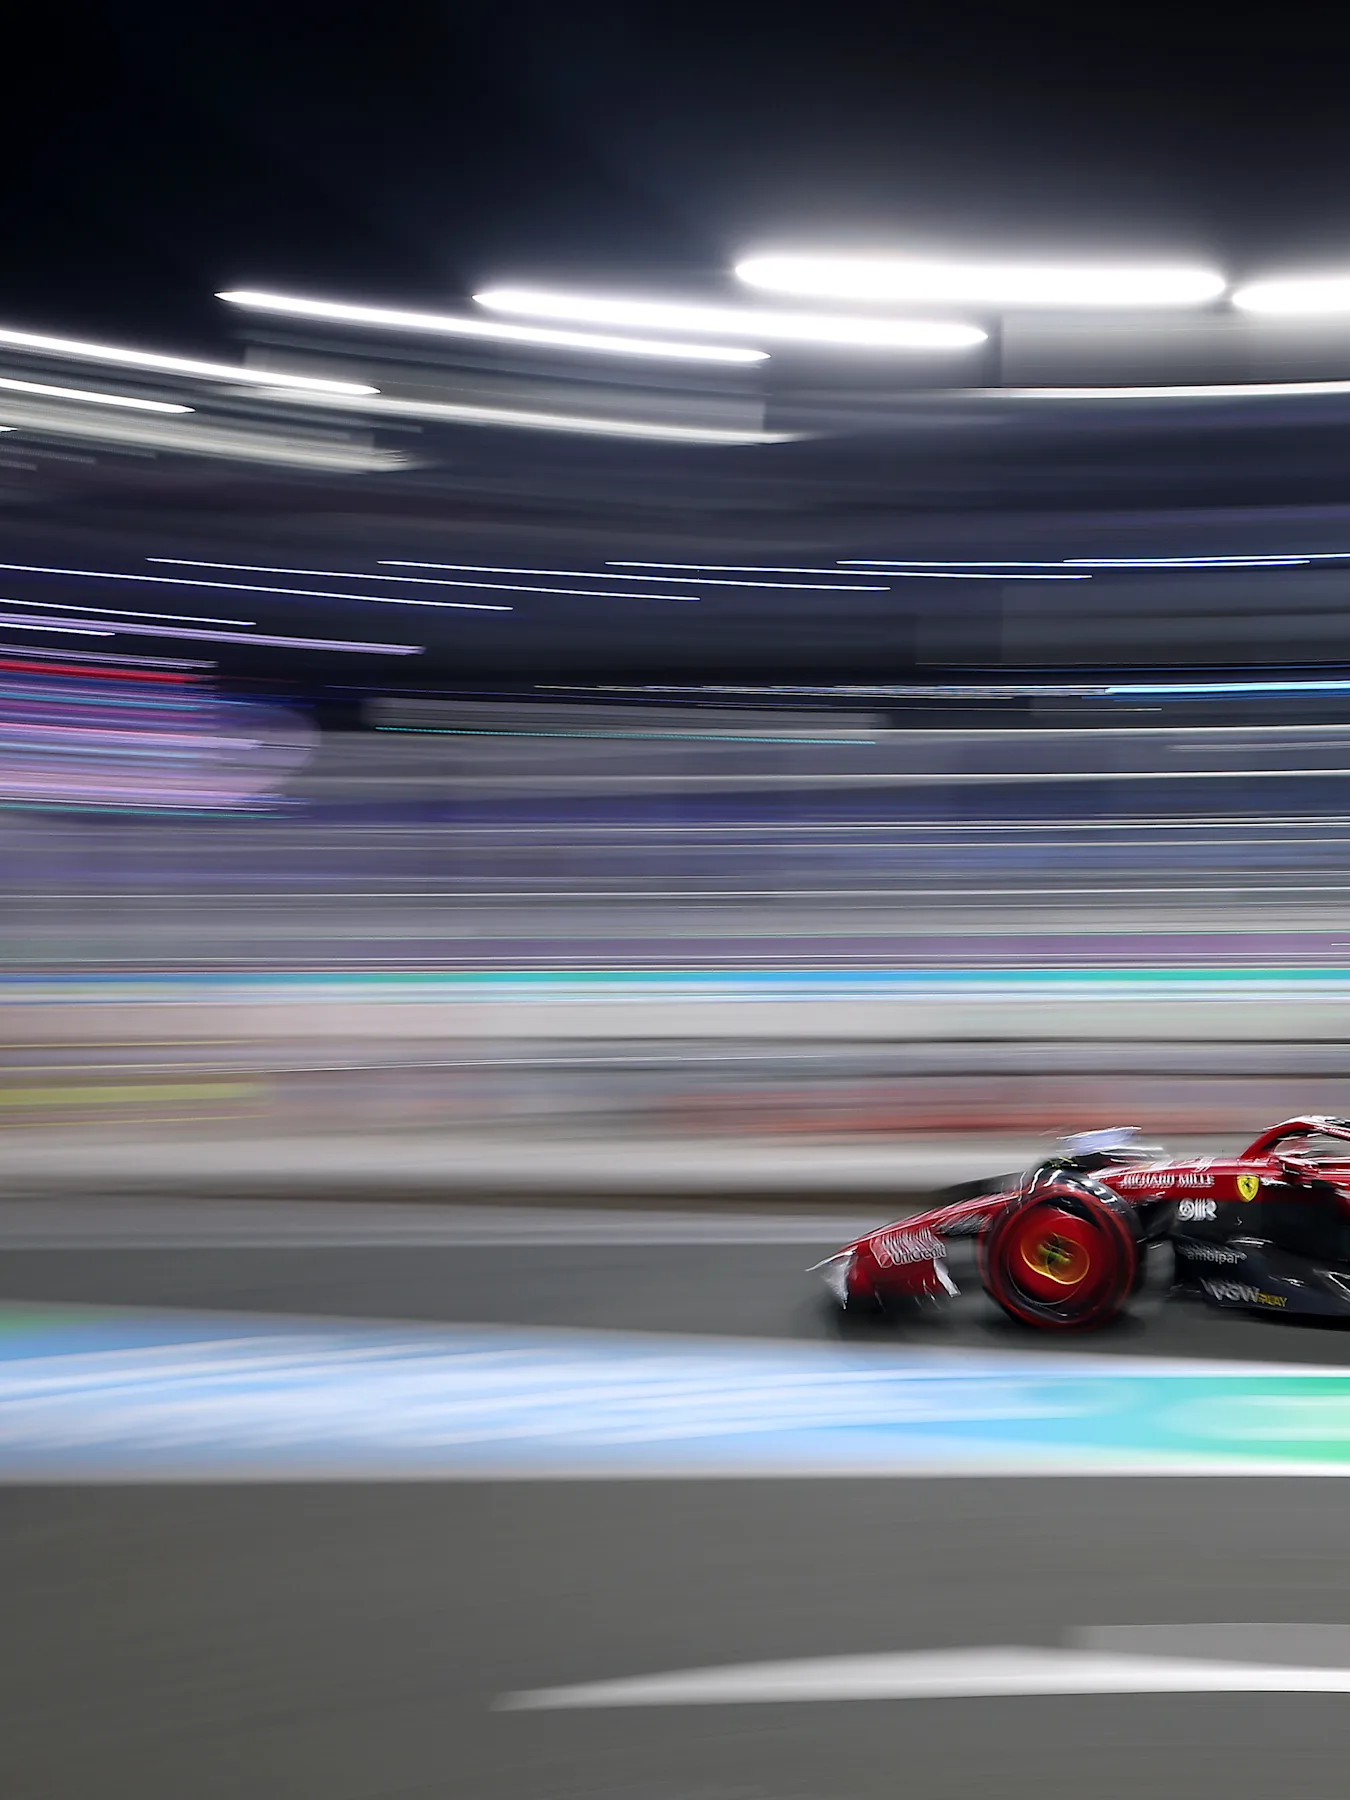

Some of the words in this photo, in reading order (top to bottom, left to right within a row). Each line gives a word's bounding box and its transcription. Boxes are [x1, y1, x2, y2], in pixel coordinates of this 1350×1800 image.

[1120, 1174, 1175, 1188] RICHARD
[1178, 1174, 1215, 1188] MILLE
[892, 1243, 947, 1267] UniCredit
